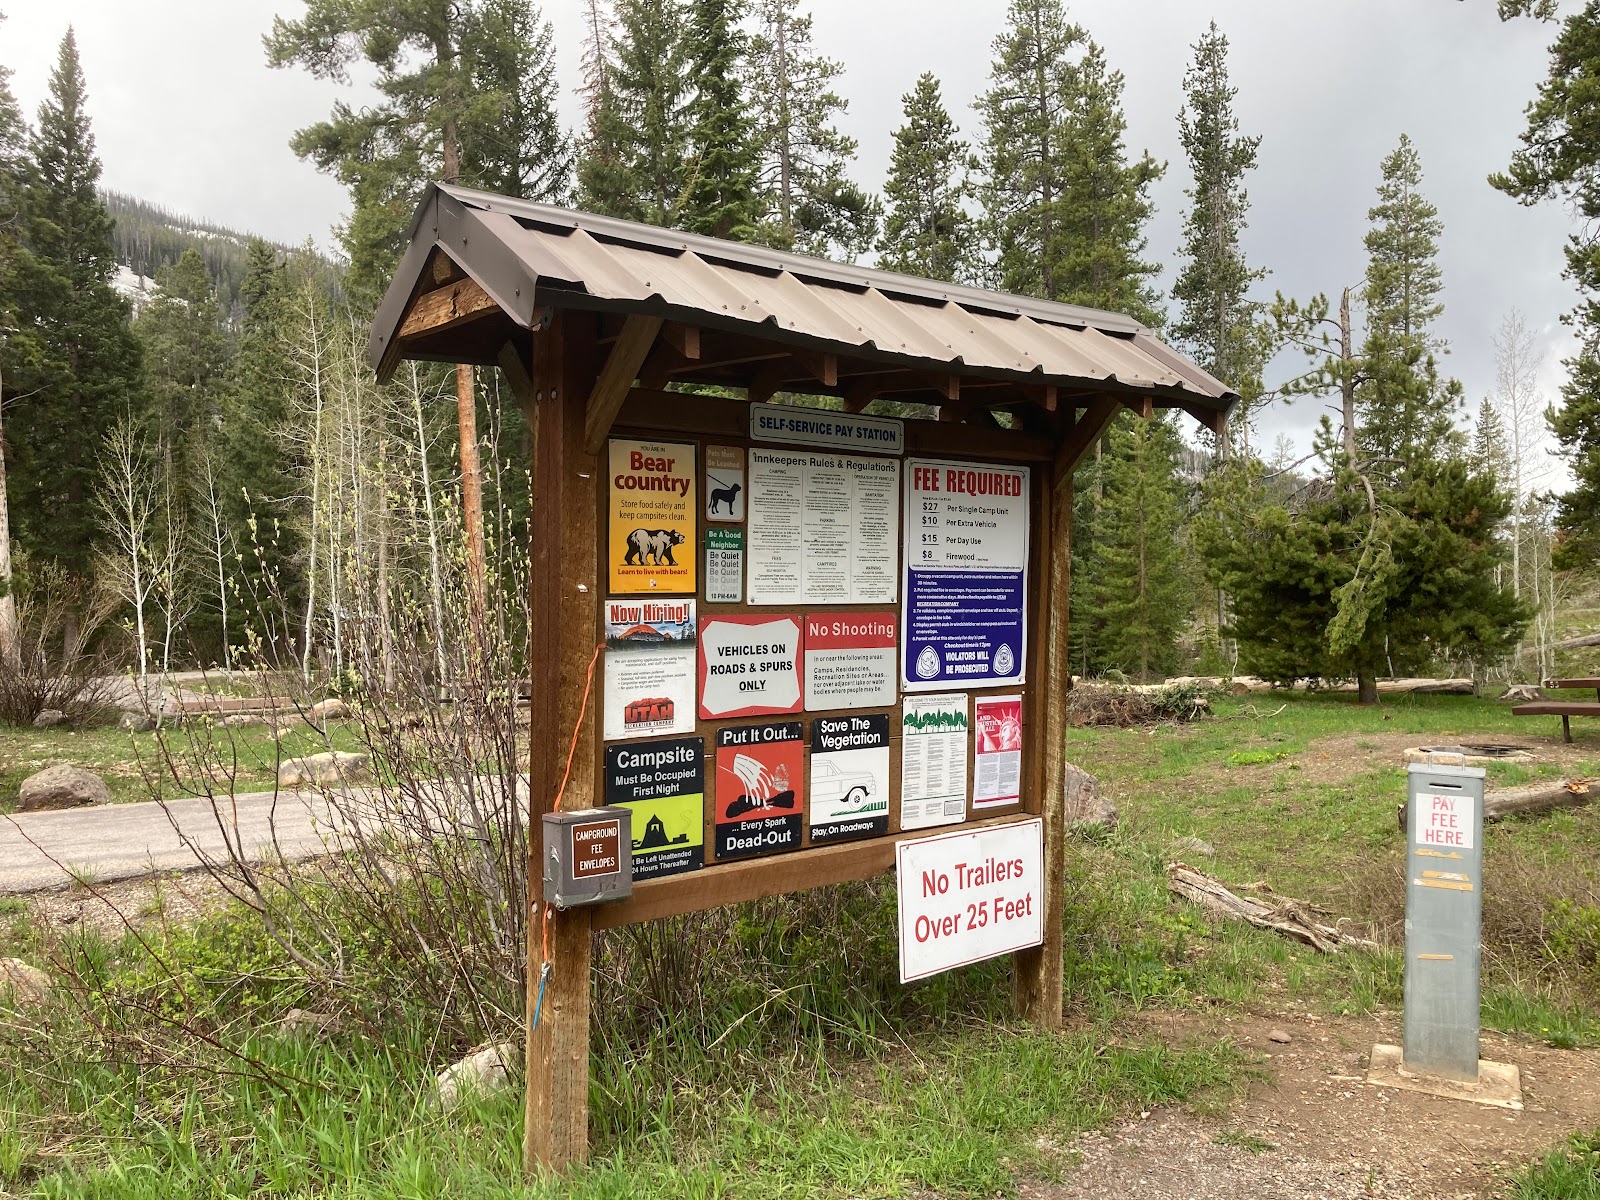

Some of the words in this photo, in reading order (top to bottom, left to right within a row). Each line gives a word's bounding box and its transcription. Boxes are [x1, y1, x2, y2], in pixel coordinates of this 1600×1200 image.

[760, 416, 832, 435] SELF-SERVICE
[836, 425, 853, 438] PAY
[856, 427, 896, 442] STATION
[630, 451, 675, 472] Bear
[810, 458, 834, 468] Rules
[838, 460, 843, 468] &
[846, 460, 896, 472] Regulations
[614, 474, 690, 498] country
[914, 468, 939, 491] FEE
[947, 470, 1021, 496] REQUIRED
[621, 500, 637, 508] Store
[639, 500, 653, 509] food
[655, 501, 672, 511] safely
[922, 502, 938, 511] $27
[959, 506, 977, 515] Single
[979, 507, 996, 515] Camp
[620, 511, 634, 520] keep
[636, 512, 667, 521] campsites
[669, 512, 687, 521] clean.
[922, 516, 937, 525] $10
[711, 541, 739, 549] Neighbor
[922, 534, 937, 542] $15
[958, 537, 969, 545] Day
[922, 550, 932, 558] $8
[610, 604, 640, 624] Now
[643, 603, 688, 624] Hiring!
[809, 623, 828, 636] No
[832, 622, 894, 637] Shooting
[718, 645, 768, 656] VEHICLES
[772, 644, 785, 654] ON
[946, 652, 975, 662] VIOLATORS
[977, 651, 989, 660] WILL
[710, 664, 746, 675] ROADS
[749, 664, 756, 672] &
[760, 661, 792, 672] SPURS
[946, 665, 954, 674] BE
[954, 664, 988, 674] PROSECUTED
[739, 680, 766, 691] ONLY
[626, 704, 673, 722] UTAH
[821, 720, 848, 733] Save
[851, 718, 870, 731] The
[723, 730, 747, 744] Put
[751, 730, 759, 742] It
[763, 727, 798, 740] Out...
[821, 732, 881, 750] Vegetation
[617, 746, 694, 769] Campsite
[616, 776, 638, 786] Must
[640, 774, 652, 782] Be
[655, 768, 696, 782] Occupied
[633, 786, 654, 797] First
[656, 783, 680, 795] Night
[1433, 797, 1456, 811] PAY
[741, 819, 763, 832] Every
[765, 817, 786, 829] Spark
[828, 826, 839, 834] On
[840, 821, 873, 834] Roadways
[1432, 813, 1457, 828] FEE
[576, 827, 617, 841] CAMPGROUND
[726, 829, 791, 850] Dead-Out
[1426, 829, 1463, 845] HERE
[591, 844, 603, 854] FEE
[580, 857, 615, 871] ENVELOPES
[646, 855, 657, 864] Left
[658, 850, 692, 861] Unattended
[640, 862, 658, 873] Hours
[660, 859, 690, 869] Thereafter
[922, 869, 949, 897] No
[955, 858, 1023, 890] Trailers
[915, 913, 961, 942] Over
[967, 901, 988, 930] 25
[994, 892, 1031, 924] Feet
